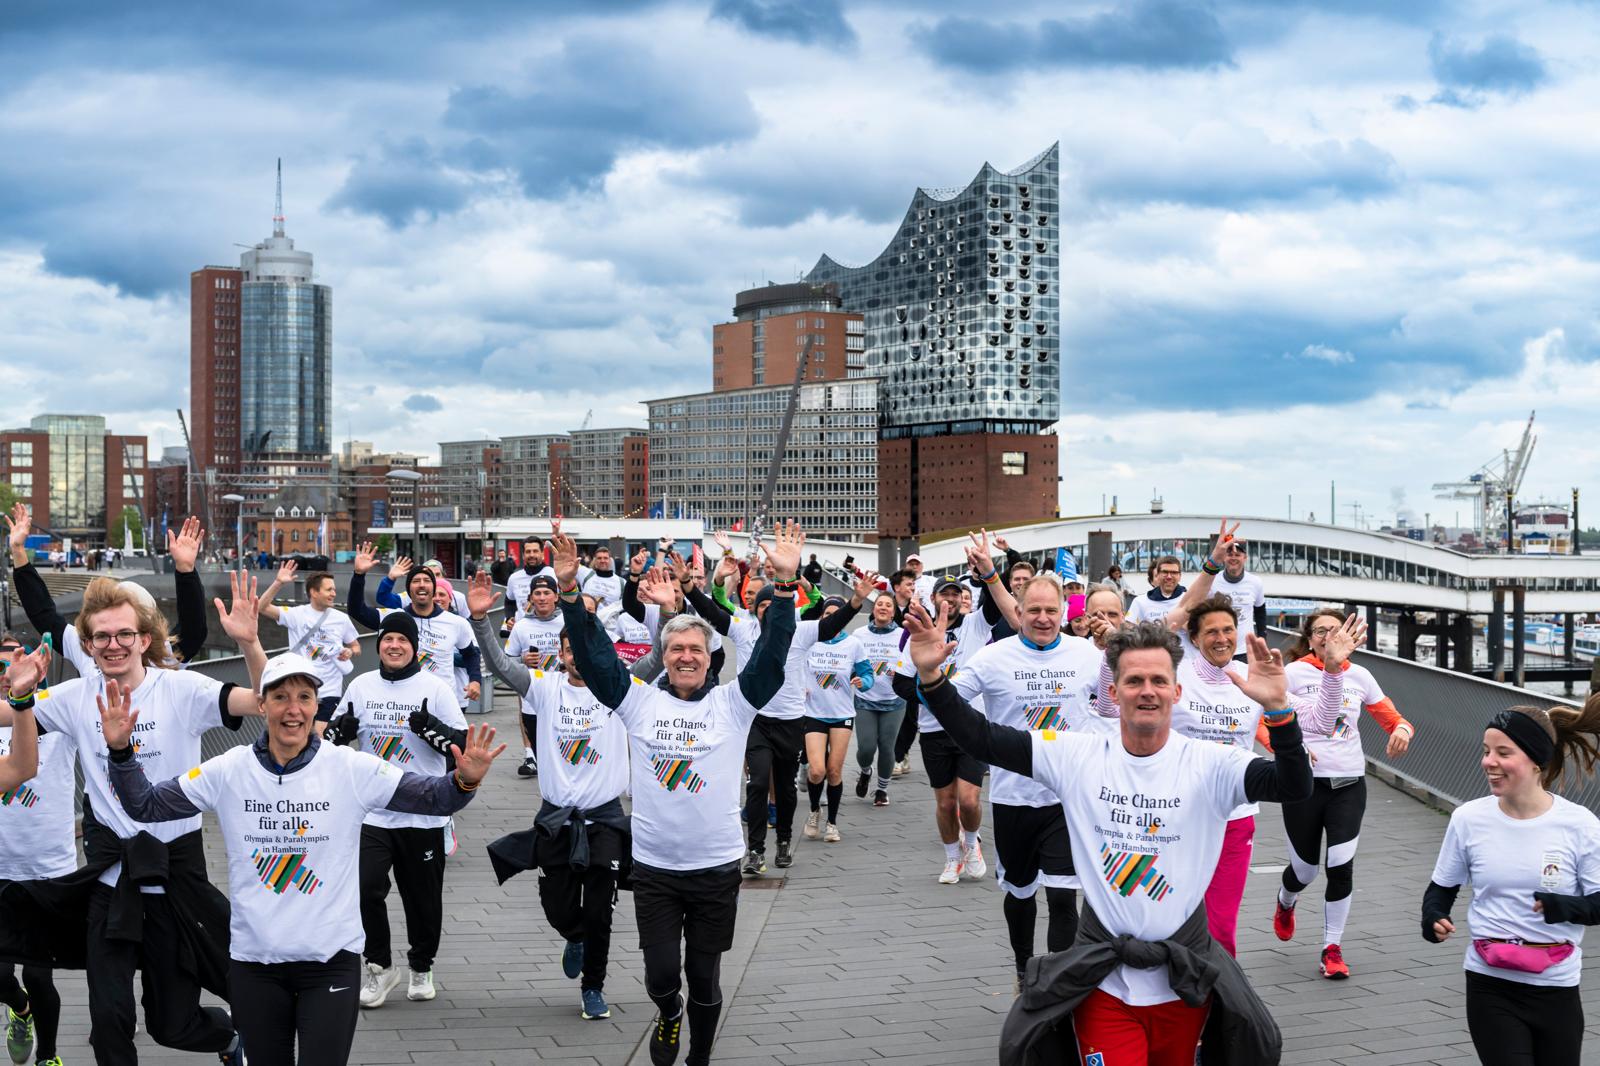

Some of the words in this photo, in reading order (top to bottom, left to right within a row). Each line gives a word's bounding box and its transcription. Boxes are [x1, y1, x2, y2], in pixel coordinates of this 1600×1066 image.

[825, 651, 847, 659] Chance
[1014, 670, 1037, 680] Eine
[1040, 669, 1076, 679] Chance
[1027, 681, 1042, 690] für
[1045, 680, 1066, 690] alle.
[366, 700, 384, 710] Eine
[386, 701, 420, 711] Chance
[1189, 701, 1212, 713] Eine
[1214, 704, 1251, 715] Chance
[373, 712, 387, 720] für
[561, 715, 574, 724] für
[1201, 714, 1216, 725] für
[1219, 716, 1242, 726] alle.
[131, 735, 145, 747] le.
[656, 729, 673, 740] für
[675, 731, 699, 742] alle.
[675, 744, 711, 752] Paralympics
[1098, 785, 1129, 805] Eine
[1131, 793, 1181, 809] Chance
[244, 799, 272, 813] Eine
[276, 799, 330, 813] Chance
[258, 816, 279, 830] für
[282, 816, 314, 830] alle.
[1110, 808, 1133, 825] für
[1136, 812, 1166, 828] alle.
[244, 834, 273, 844] Olympia
[283, 834, 330, 844] Paralympics
[1094, 825, 1124, 838] Olympia
[1126, 832, 1133, 840] &
[1135, 833, 1181, 844] Paralympics
[262, 845, 270, 853] in
[272, 845, 309, 855] Hamburg.
[1111, 840, 1120, 849] in
[1121, 842, 1161, 855] Hamburg.
